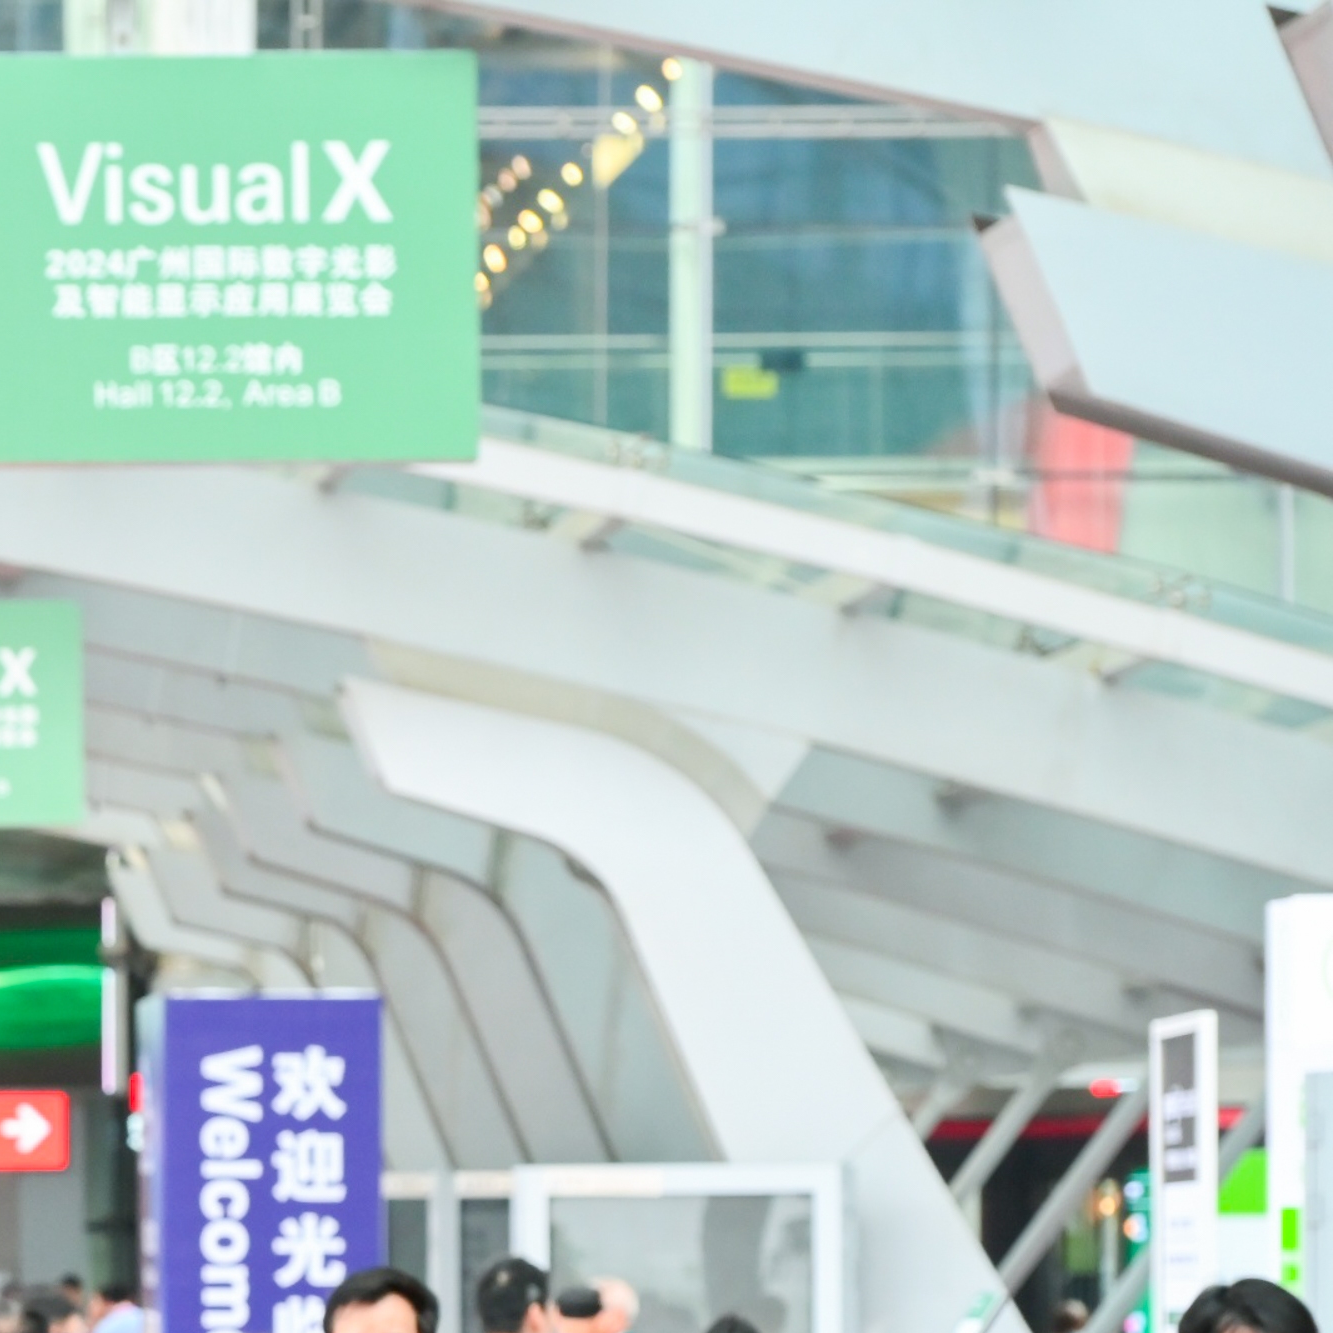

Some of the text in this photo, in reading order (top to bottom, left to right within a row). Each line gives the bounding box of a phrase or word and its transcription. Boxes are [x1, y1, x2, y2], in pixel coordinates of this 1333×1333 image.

[94, 380, 153, 408] Hall
[244, 380, 314, 407] Area
[318, 379, 341, 406] B
